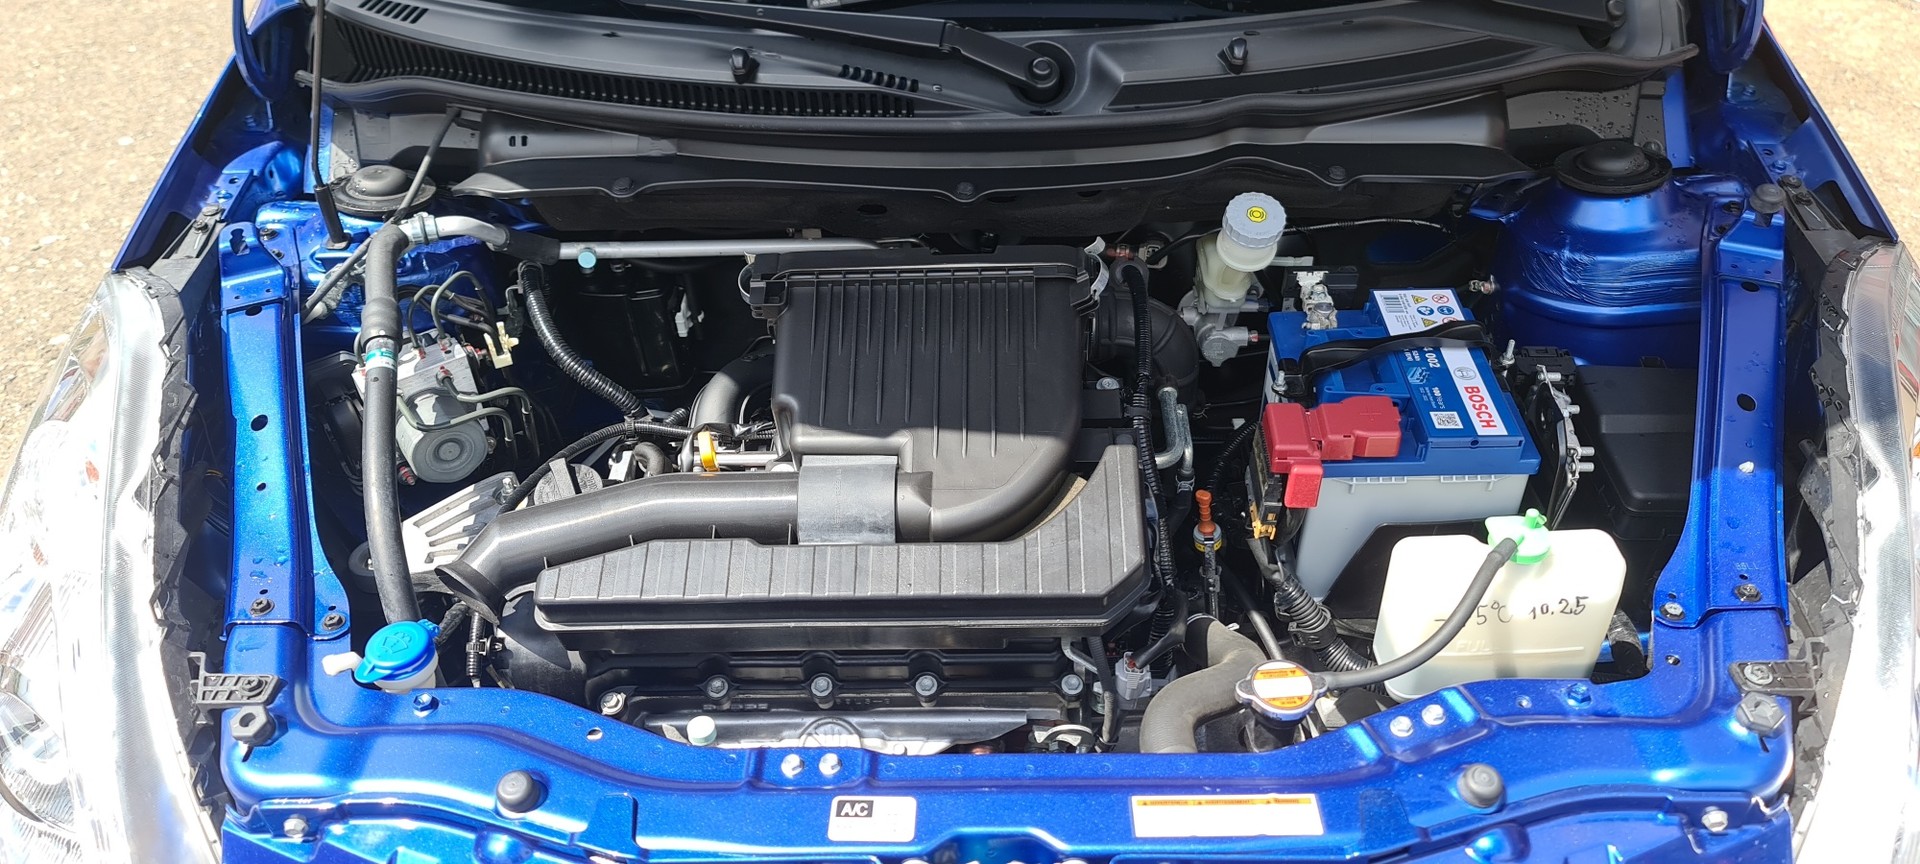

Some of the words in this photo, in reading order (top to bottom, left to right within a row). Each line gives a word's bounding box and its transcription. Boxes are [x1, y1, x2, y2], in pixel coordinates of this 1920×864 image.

[1425, 352, 1441, 368] 002
[1463, 386, 1497, 428] BOSCH
[1528, 596, 1589, 620] 10.25
[840, 802, 868, 816] A/C
